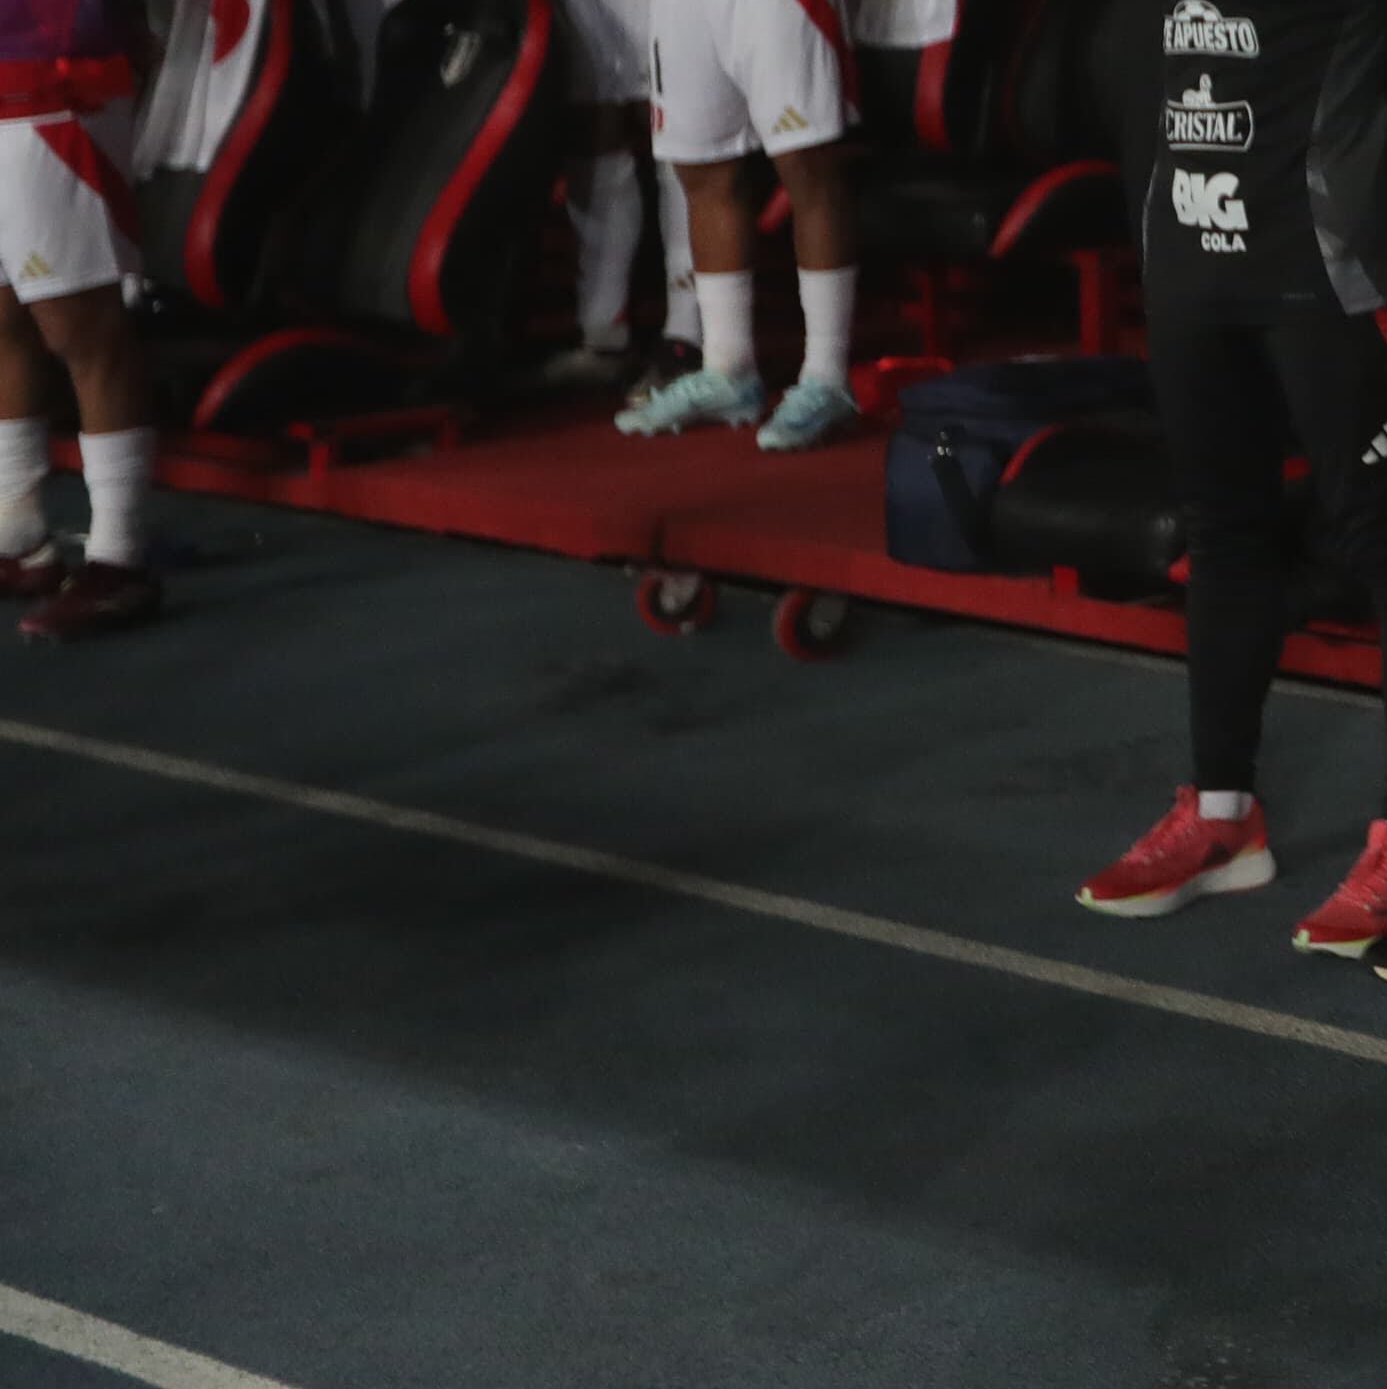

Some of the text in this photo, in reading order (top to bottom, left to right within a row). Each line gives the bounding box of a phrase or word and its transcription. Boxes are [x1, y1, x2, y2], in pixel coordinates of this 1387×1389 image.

[1174, 20, 1254, 54] APUESTO
[1166, 108, 1242, 143] CRISTAL
[1172, 168, 1249, 231] BIG
[1201, 231, 1247, 253] COLA
